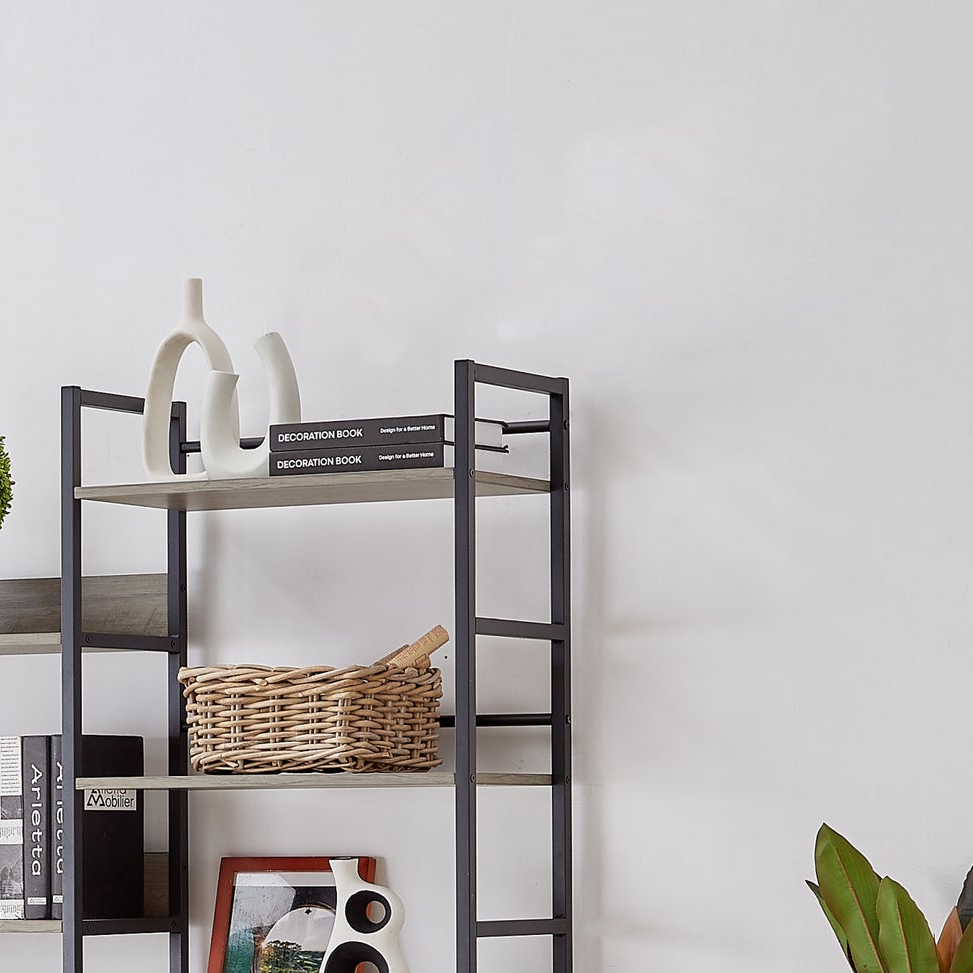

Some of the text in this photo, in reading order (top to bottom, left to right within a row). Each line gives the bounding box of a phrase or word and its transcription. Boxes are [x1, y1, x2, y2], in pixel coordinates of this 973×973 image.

[278, 428, 363, 443] DECORATION BOOK
[380, 426, 395, 434] Design
[277, 455, 362, 469] DECORATION BOOK
[379, 453, 394, 461] Design
[87, 793, 134, 808] Mobilier
[31, 764, 43, 876] Arletta
